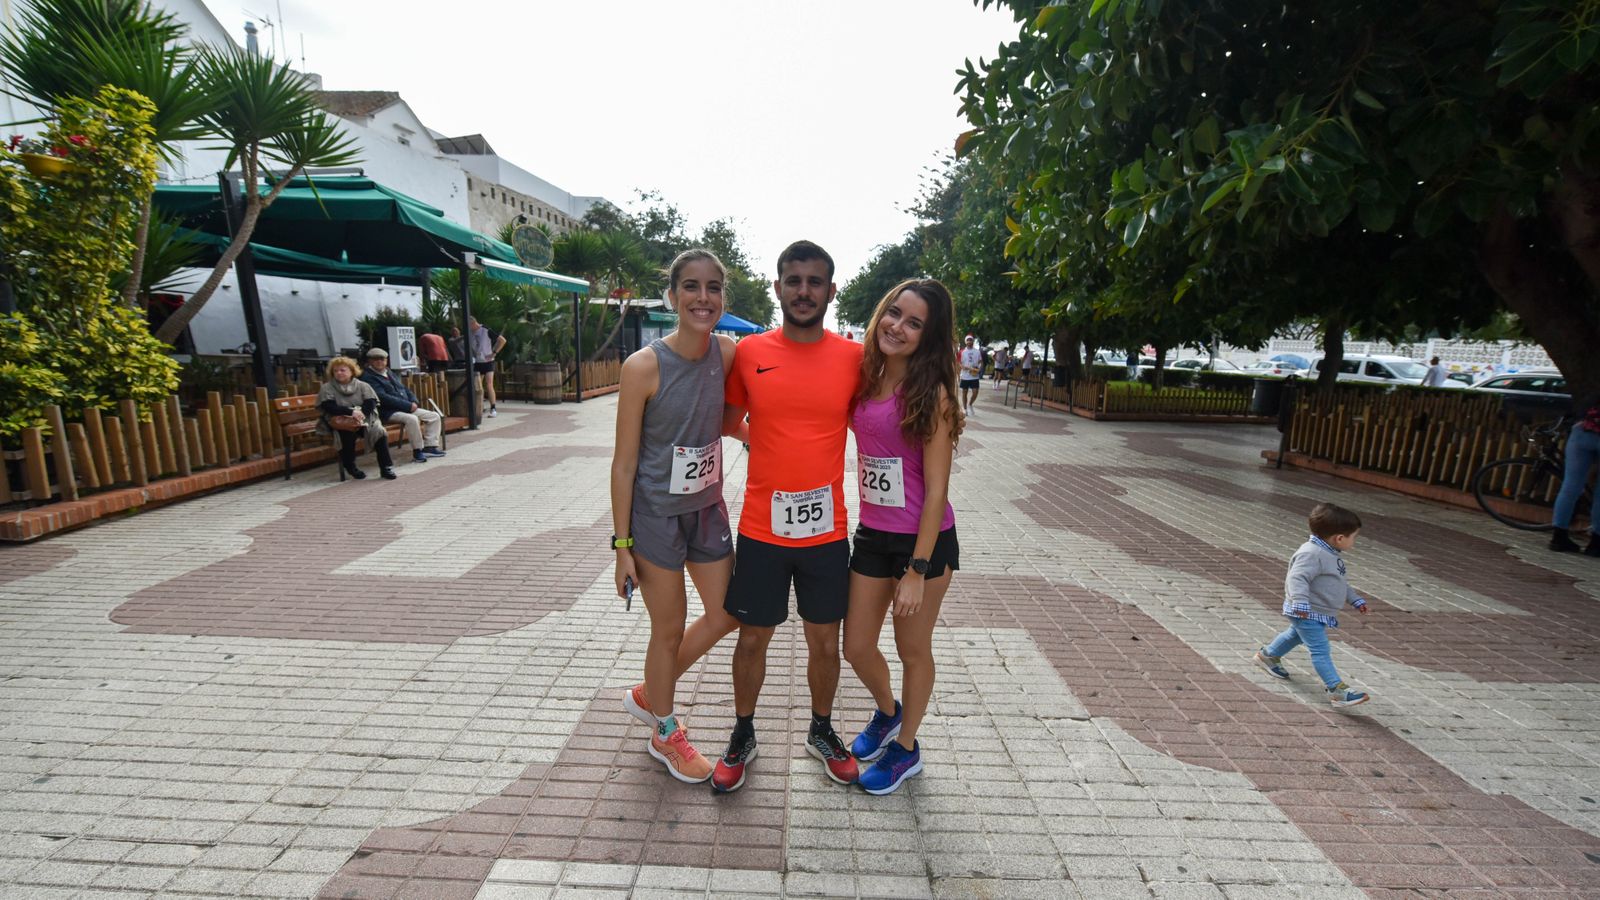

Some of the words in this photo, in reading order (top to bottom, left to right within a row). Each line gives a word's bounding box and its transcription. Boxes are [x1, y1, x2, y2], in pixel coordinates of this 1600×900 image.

[685, 455, 715, 480] 225
[804, 487, 829, 496] SILVESTRE
[862, 469, 891, 492] 226
[785, 502, 823, 524] 155
